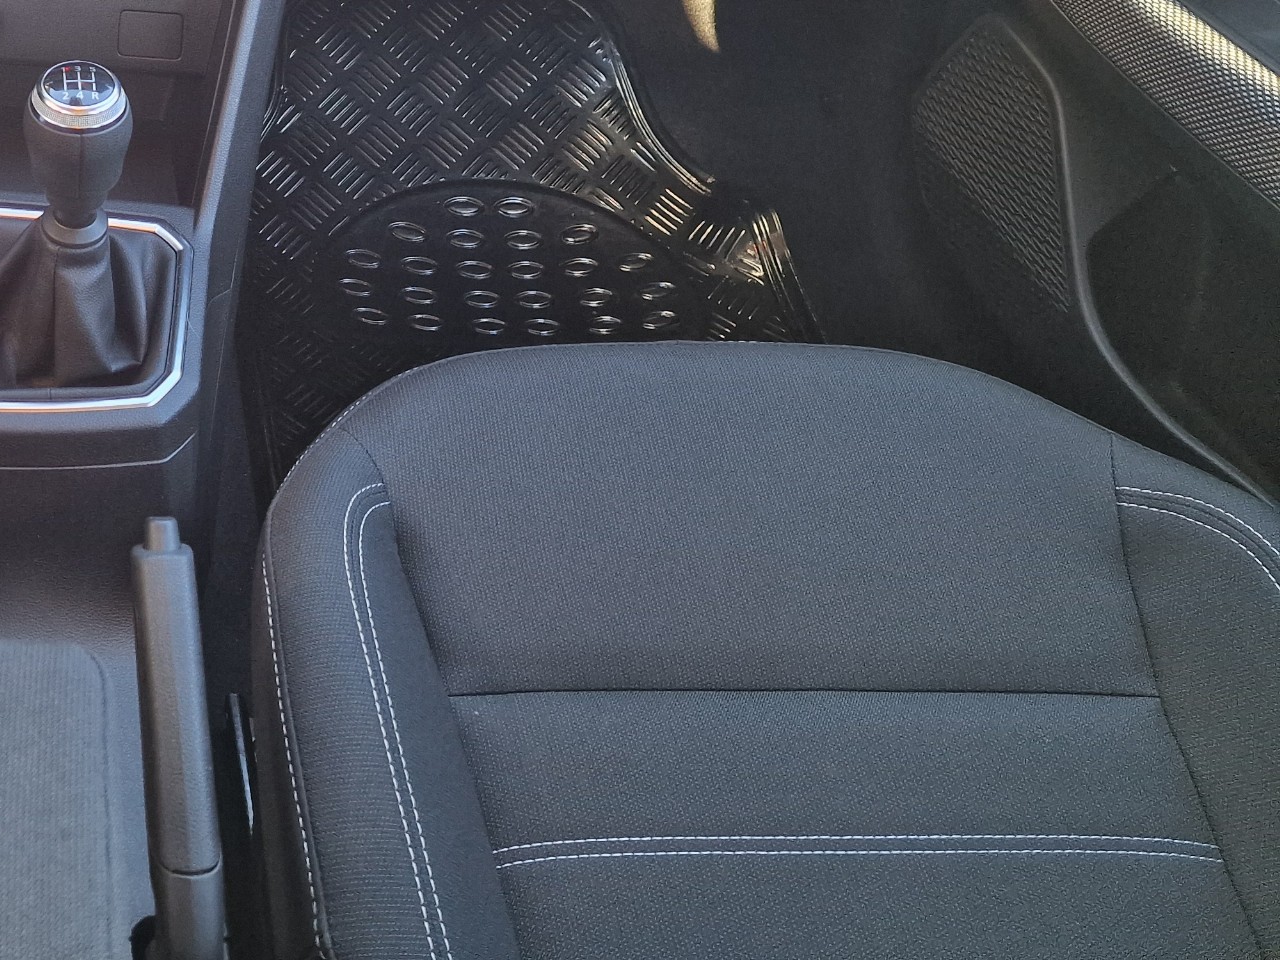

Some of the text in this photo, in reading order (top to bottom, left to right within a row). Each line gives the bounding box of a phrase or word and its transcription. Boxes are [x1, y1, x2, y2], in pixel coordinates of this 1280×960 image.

[62, 91, 99, 100] 2 4 R
